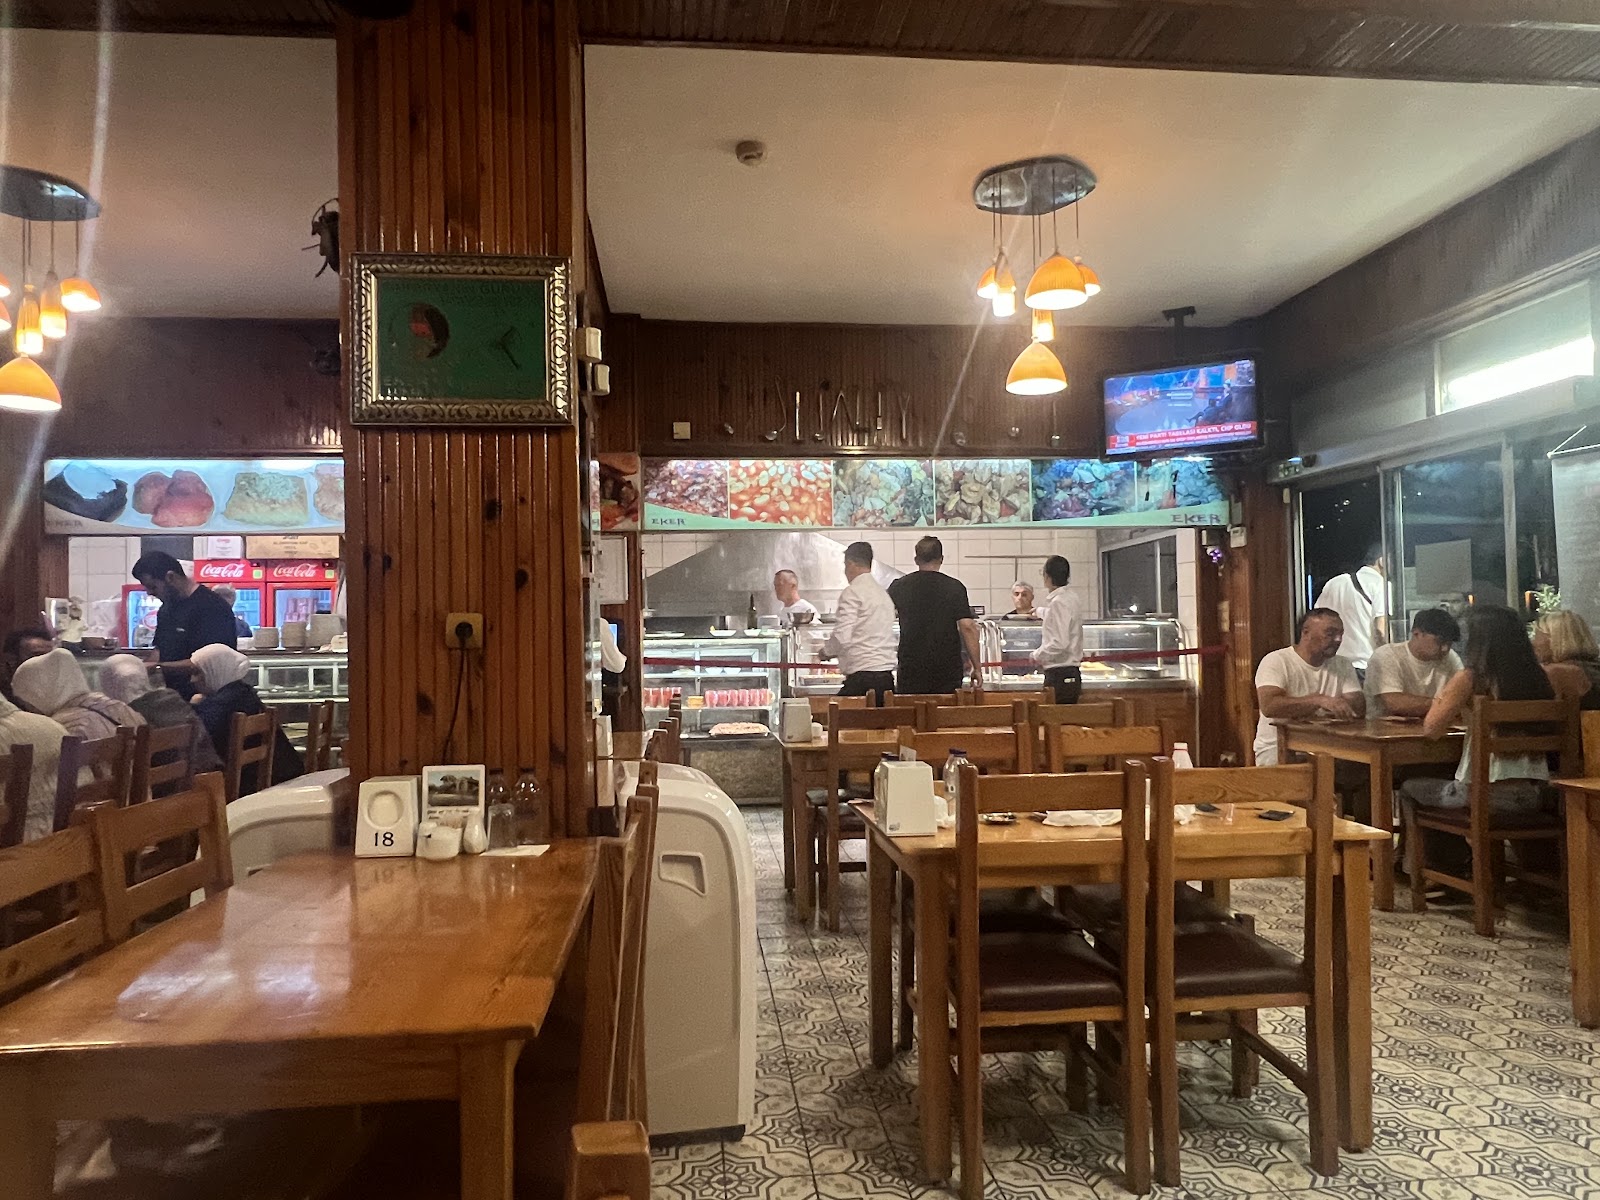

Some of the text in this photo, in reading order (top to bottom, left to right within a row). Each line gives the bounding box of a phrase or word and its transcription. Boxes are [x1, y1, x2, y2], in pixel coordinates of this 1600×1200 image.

[651, 518, 686, 526] EKER
[1170, 513, 1221, 525] EKER
[199, 563, 246, 578] Coca-Cola
[273, 563, 318, 578] Coca-Cola
[374, 831, 394, 847] 18
